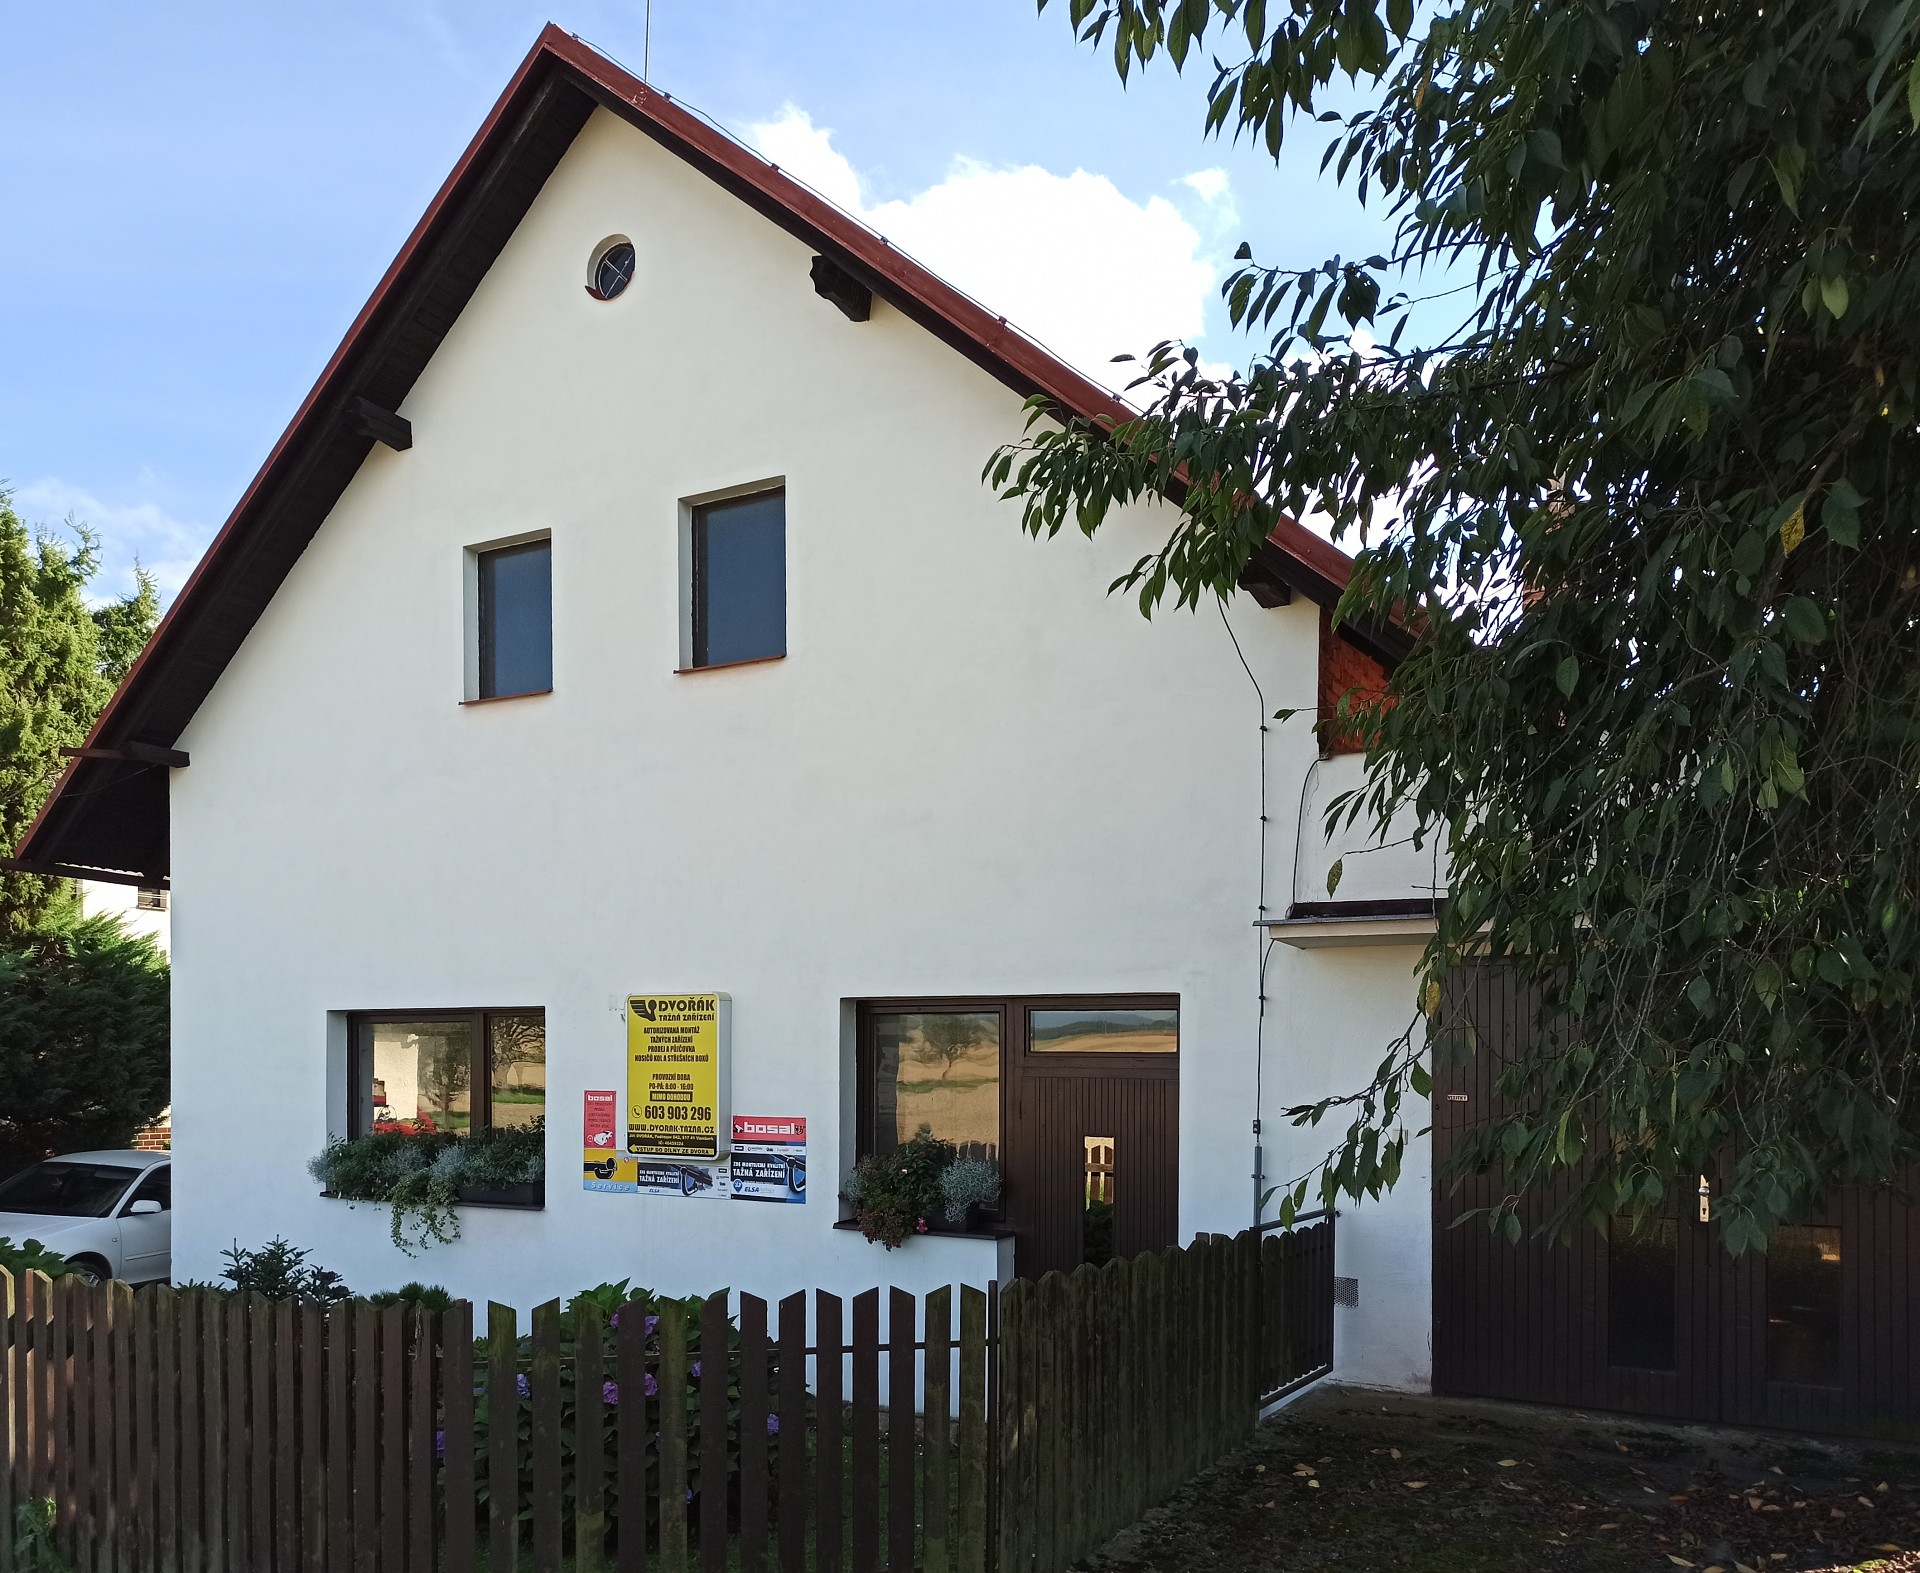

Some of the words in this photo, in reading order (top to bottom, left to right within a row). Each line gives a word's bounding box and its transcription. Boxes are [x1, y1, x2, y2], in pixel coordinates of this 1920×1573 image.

[658, 997, 715, 1012] DVOŘÁK
[658, 1013, 681, 1021] TAŽNÁ
[682, 1013, 715, 1021] ZAŘÍZENÍ
[643, 1026, 679, 1034] AUTORIZOVANÁ
[680, 1026, 700, 1034] MONTÁŽ
[670, 1044, 696, 1053] PŮJČOVNA
[667, 1054, 695, 1062] STŘEŠNÍCH
[695, 1054, 709, 1062] BOXŮ
[645, 1105, 665, 1119] 603
[667, 1106, 688, 1120] 903
[690, 1106, 711, 1121] 296
[743, 1121, 795, 1135] bosal
[733, 1167, 753, 1177] TAŽNÁ
[755, 1168, 785, 1179] ZAŘÍZENÍ
[639, 1174, 655, 1182] TAŽNÁ
[656, 1174, 679, 1183] ZAŘÍZENÍ
[591, 1181, 630, 1191] Service
